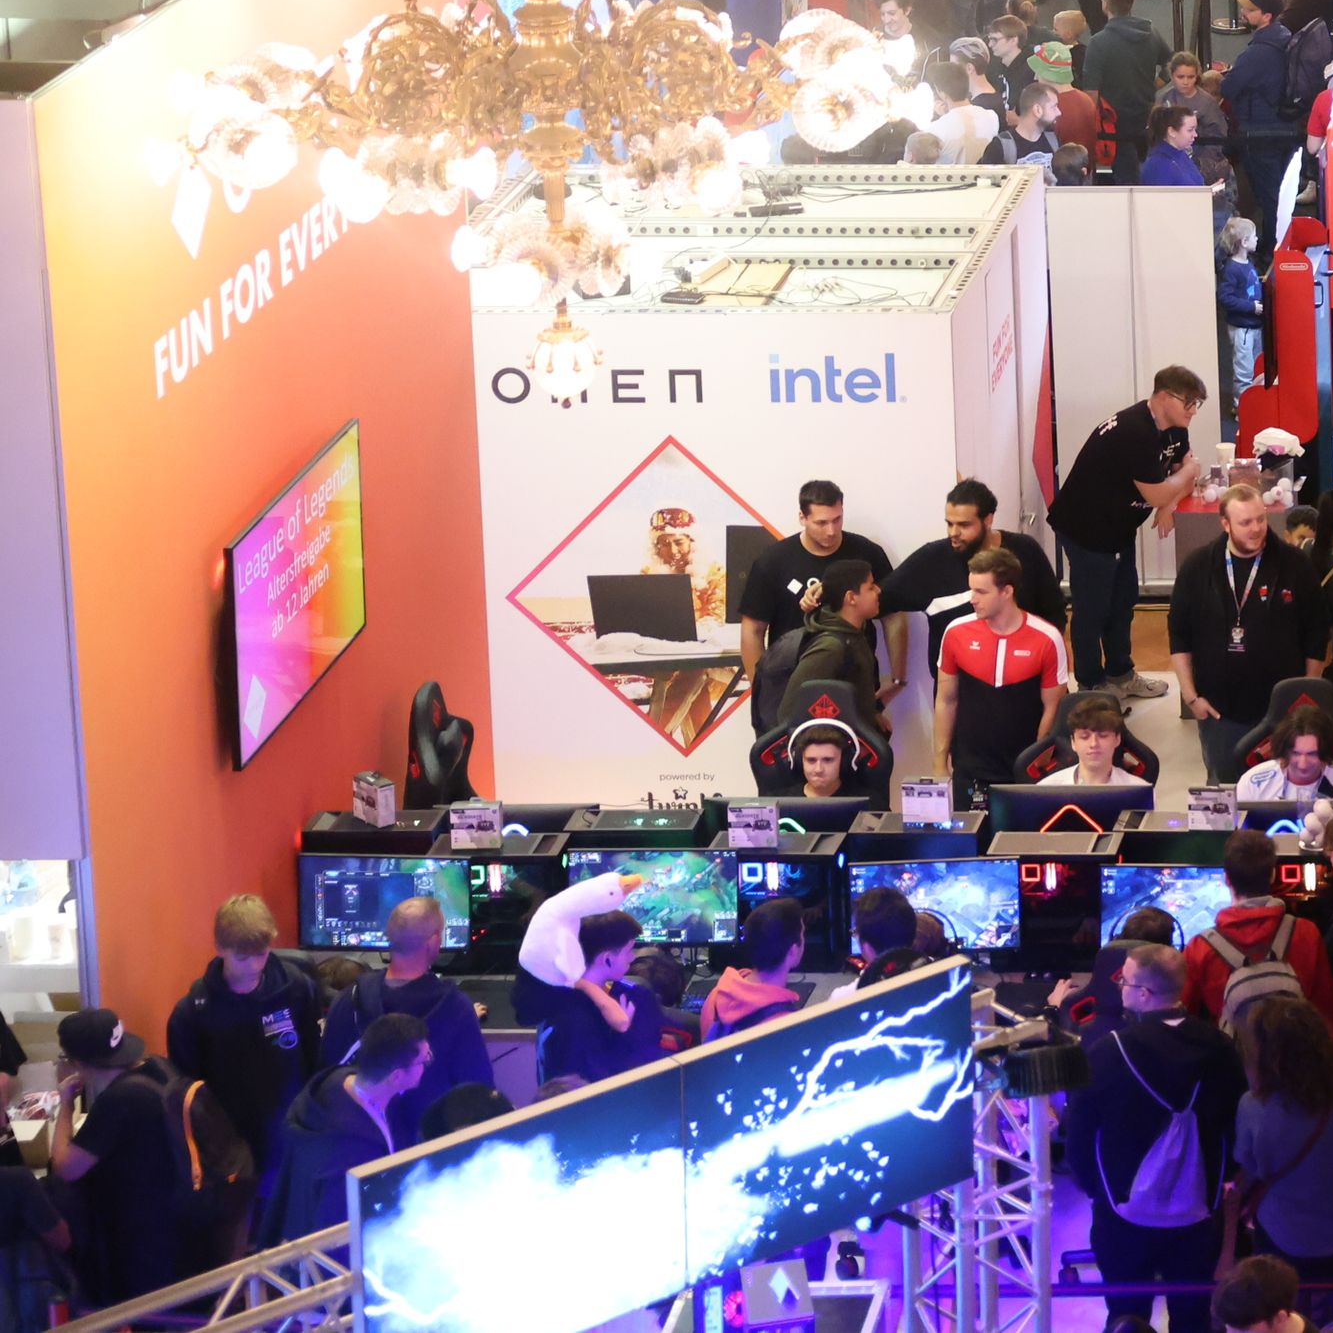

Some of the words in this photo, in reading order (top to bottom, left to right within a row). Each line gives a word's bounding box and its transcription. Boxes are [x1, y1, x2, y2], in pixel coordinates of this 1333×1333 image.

[154, 297, 214, 400] FUN
[220, 249, 274, 341] FOR
[238, 527, 285, 594] League
[287, 499, 301, 541] of
[304, 453, 354, 524] Legends
[267, 523, 331, 606] Altersfreigabe
[271, 609, 284, 639] ab
[286, 593, 298, 623] 12
[300, 562, 329, 611] Jahren
[659, 773, 701, 781] powered
[703, 772, 715, 781] by
